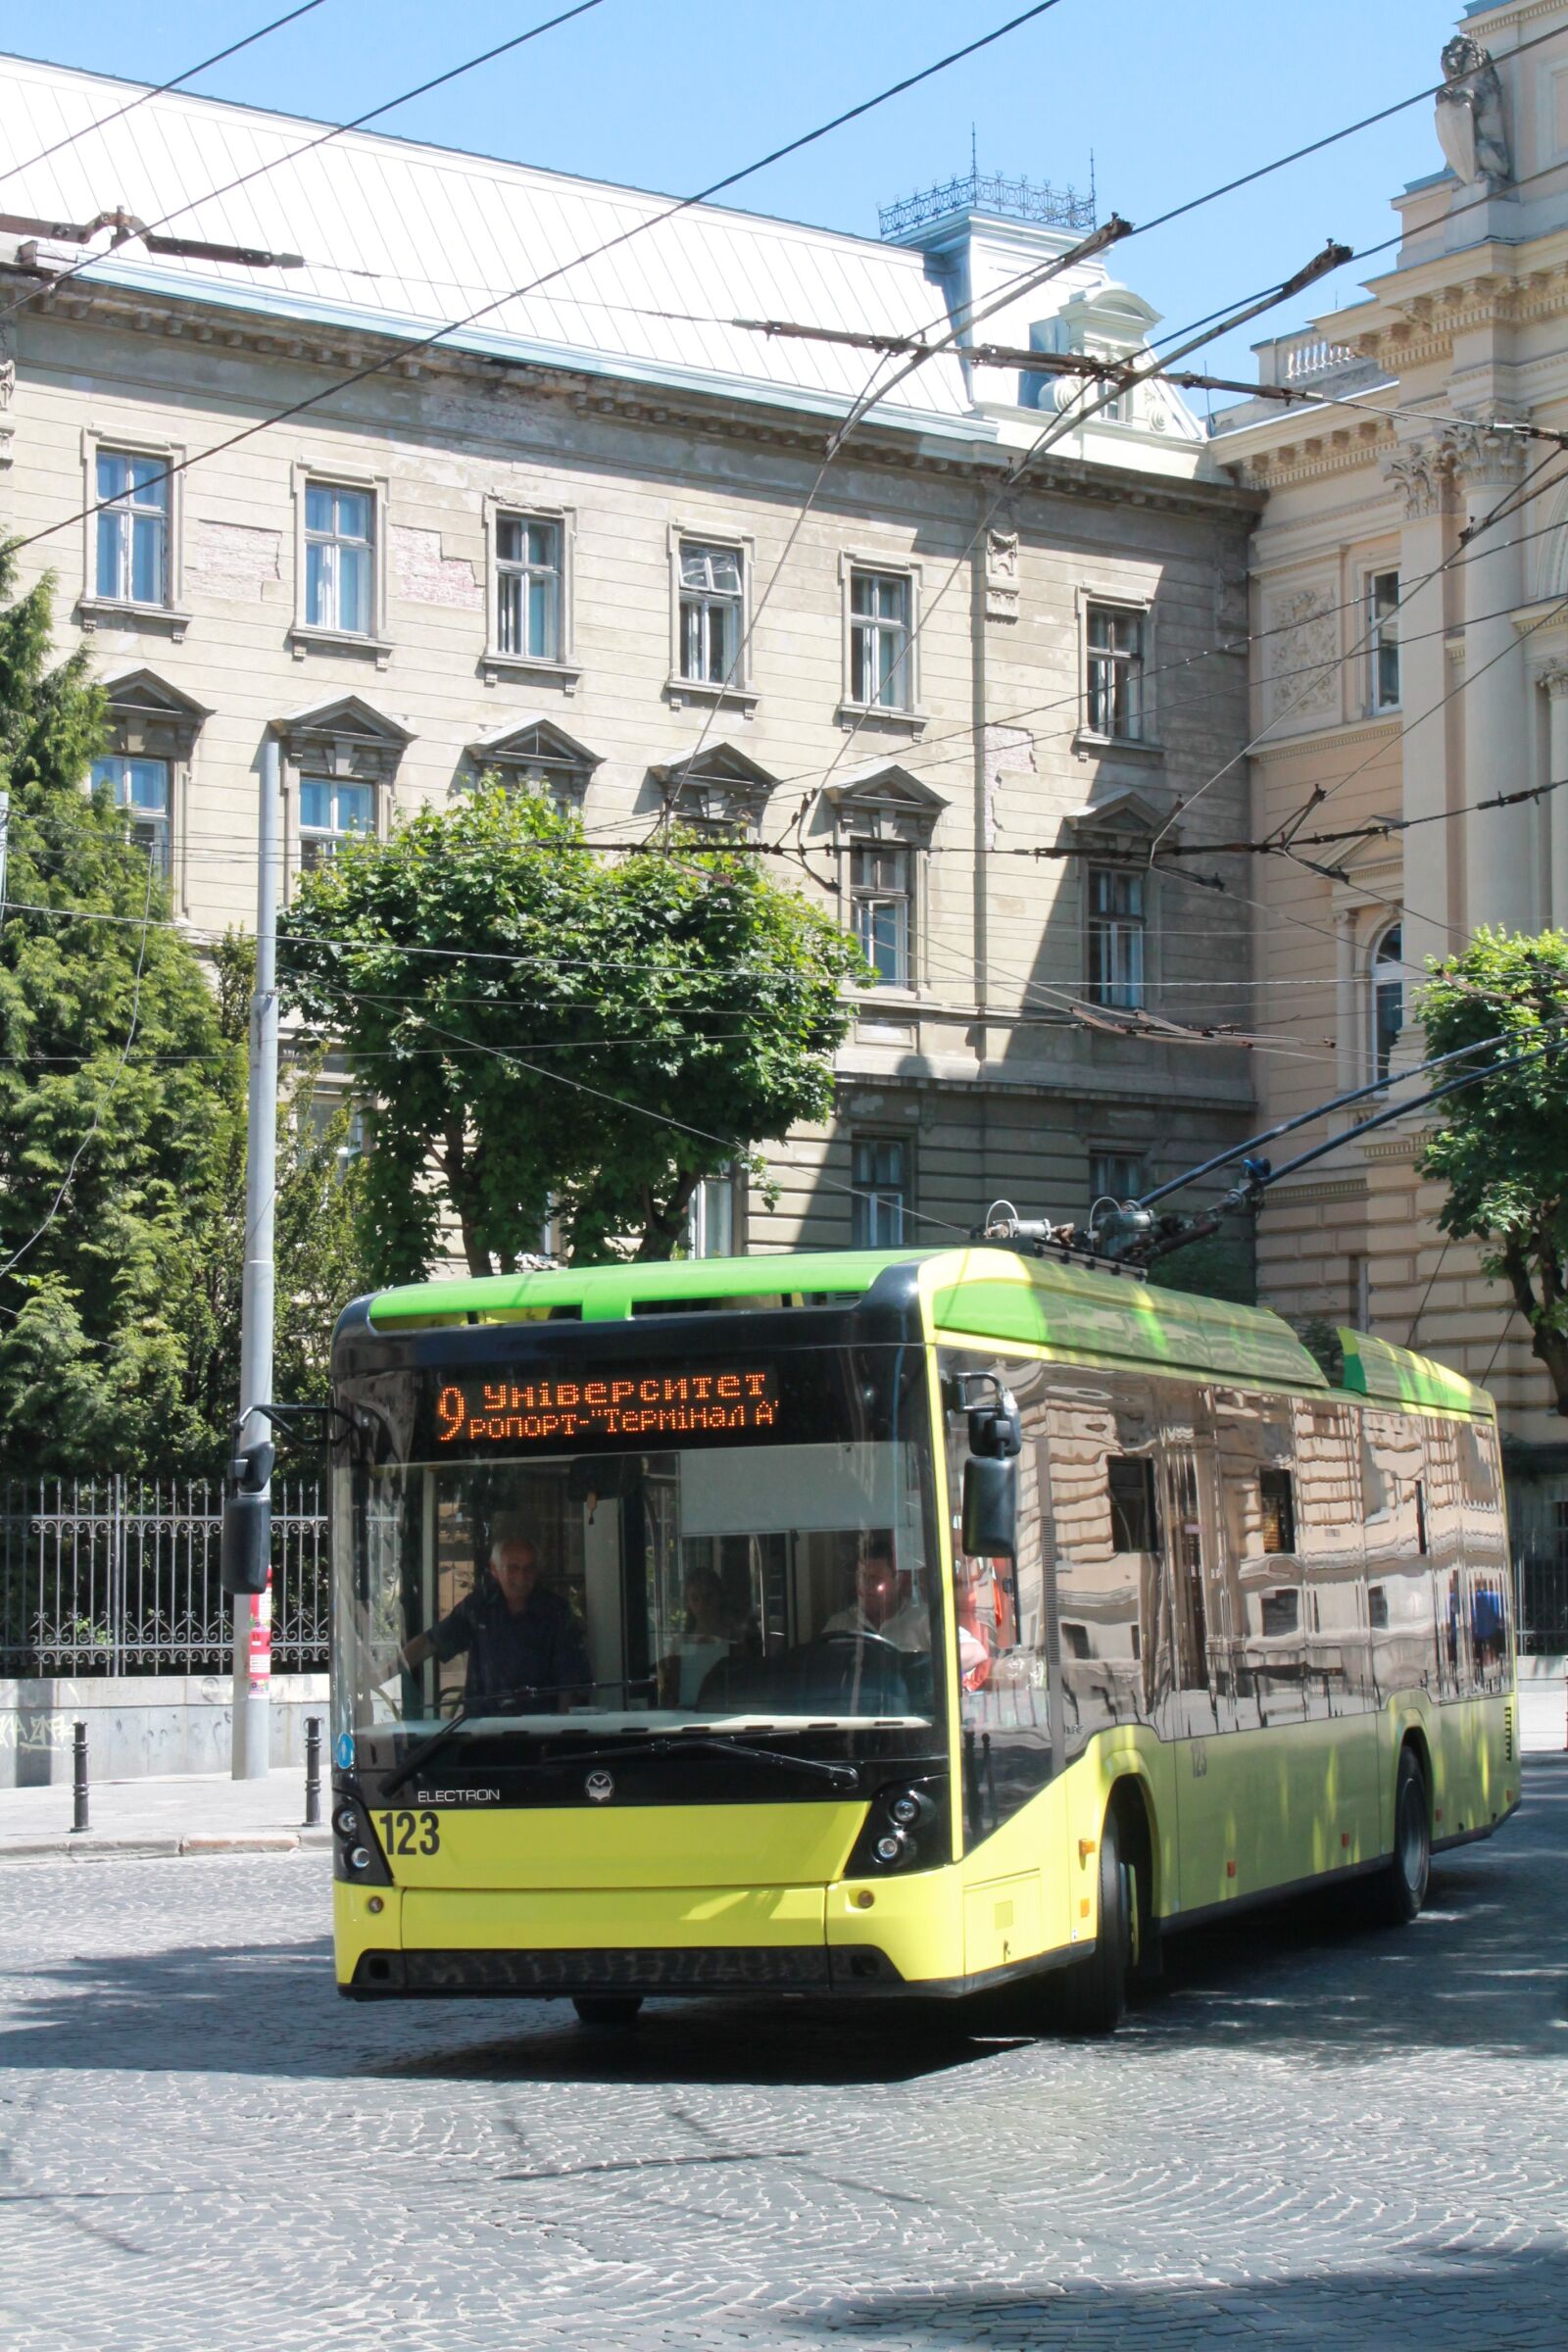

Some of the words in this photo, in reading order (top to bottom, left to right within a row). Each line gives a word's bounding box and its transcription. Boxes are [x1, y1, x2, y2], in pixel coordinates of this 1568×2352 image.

[484, 1374, 765, 1409] Університет
[438, 1387, 465, 1441] 9
[1190, 1739, 1207, 1779] 123
[417, 1788, 500, 1802] ELECTRON
[379, 1811, 440, 1856] 123
